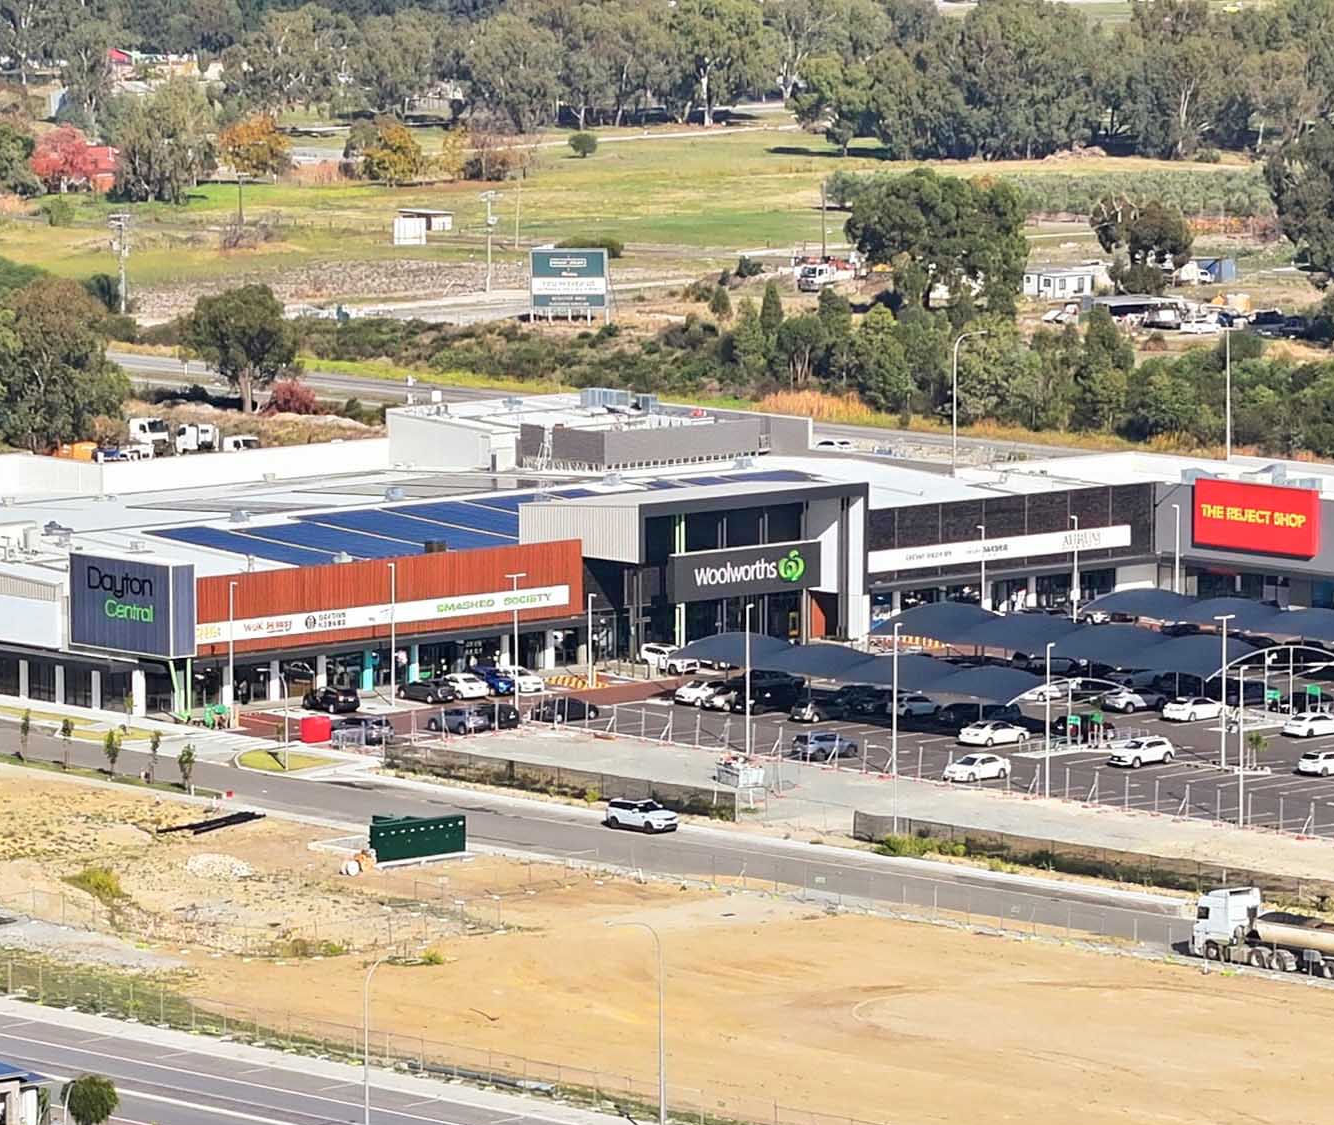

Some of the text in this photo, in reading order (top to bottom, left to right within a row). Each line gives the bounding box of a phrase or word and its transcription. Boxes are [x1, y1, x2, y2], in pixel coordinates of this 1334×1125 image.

[1201, 504, 1306, 528] THE REJECT SHOP
[88, 566, 154, 599] Dayton
[694, 558, 778, 587] Woolworths
[105, 600, 154, 622] Central
[436, 593, 552, 613] SMASHED SOCIETY
